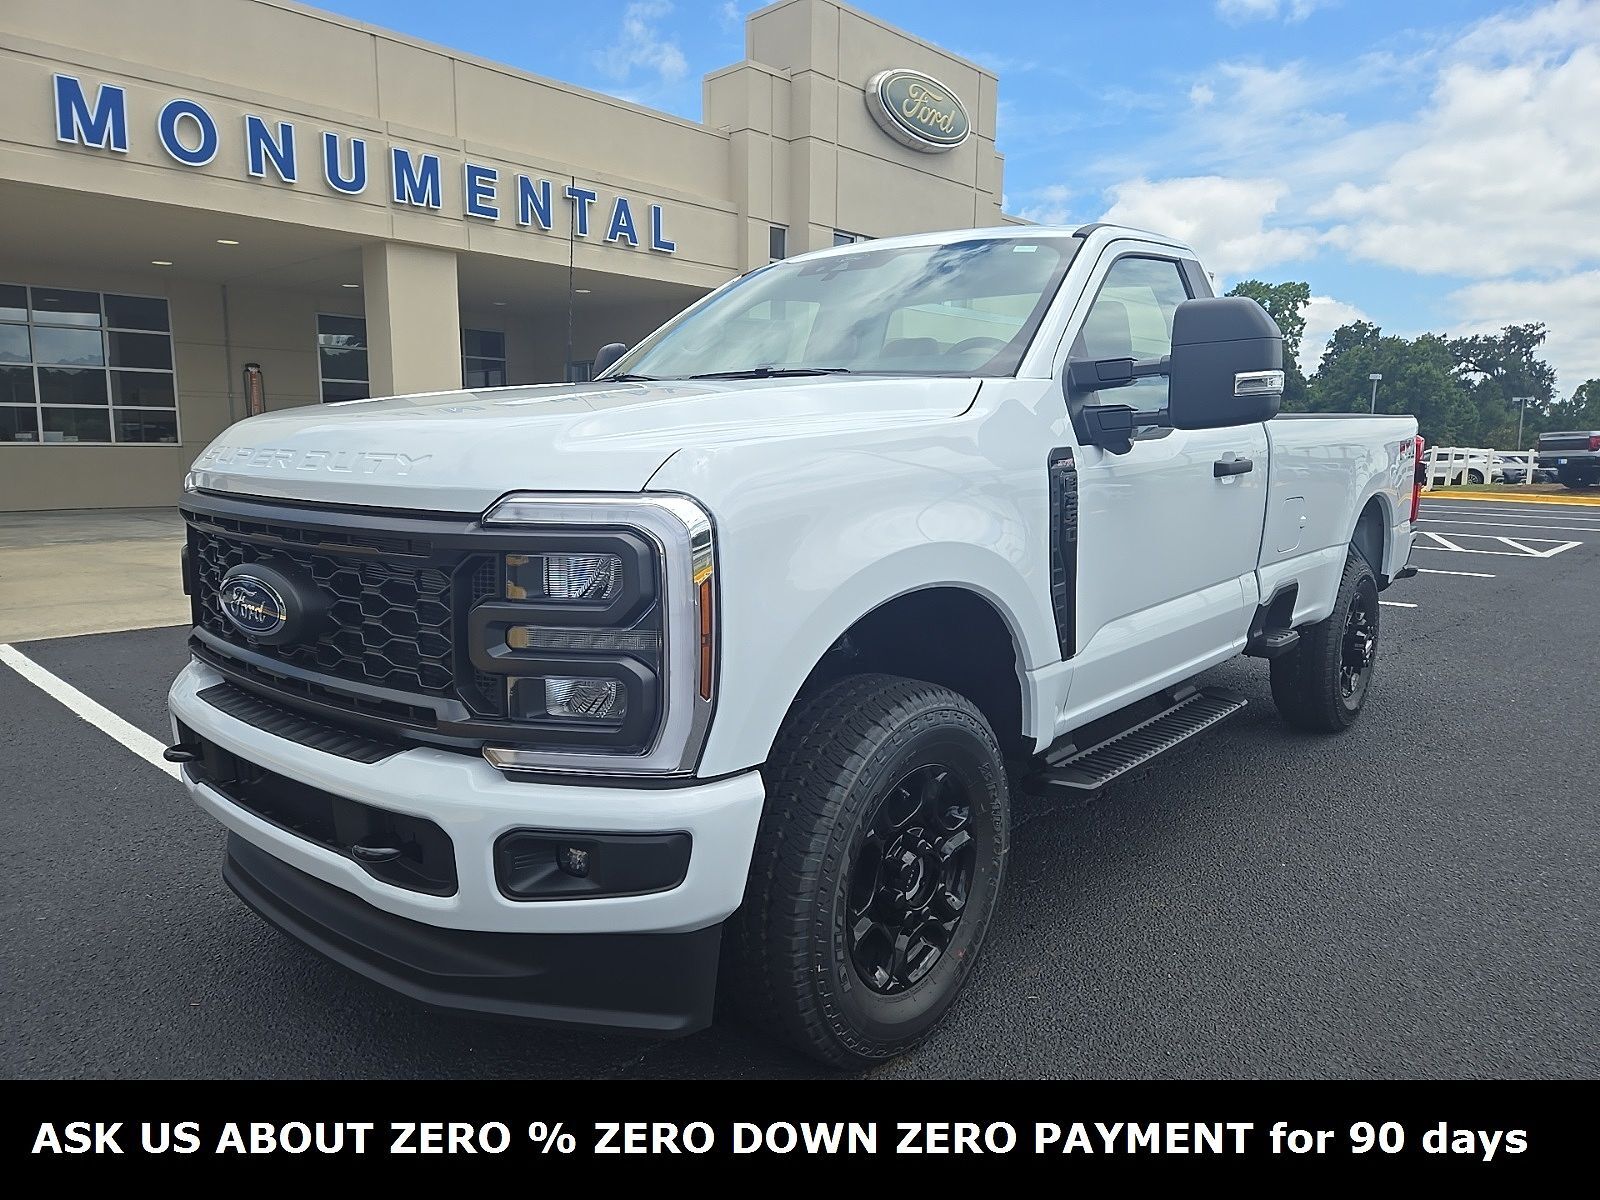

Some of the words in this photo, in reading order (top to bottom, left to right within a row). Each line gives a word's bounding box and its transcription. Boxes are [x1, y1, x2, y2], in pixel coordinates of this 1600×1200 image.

[902, 83, 956, 133] Ford
[53, 73, 678, 254] MONUMENTAL
[202, 446, 296, 469] SUPER
[296, 450, 434, 475] DUTY
[229, 586, 267, 623] Ford
